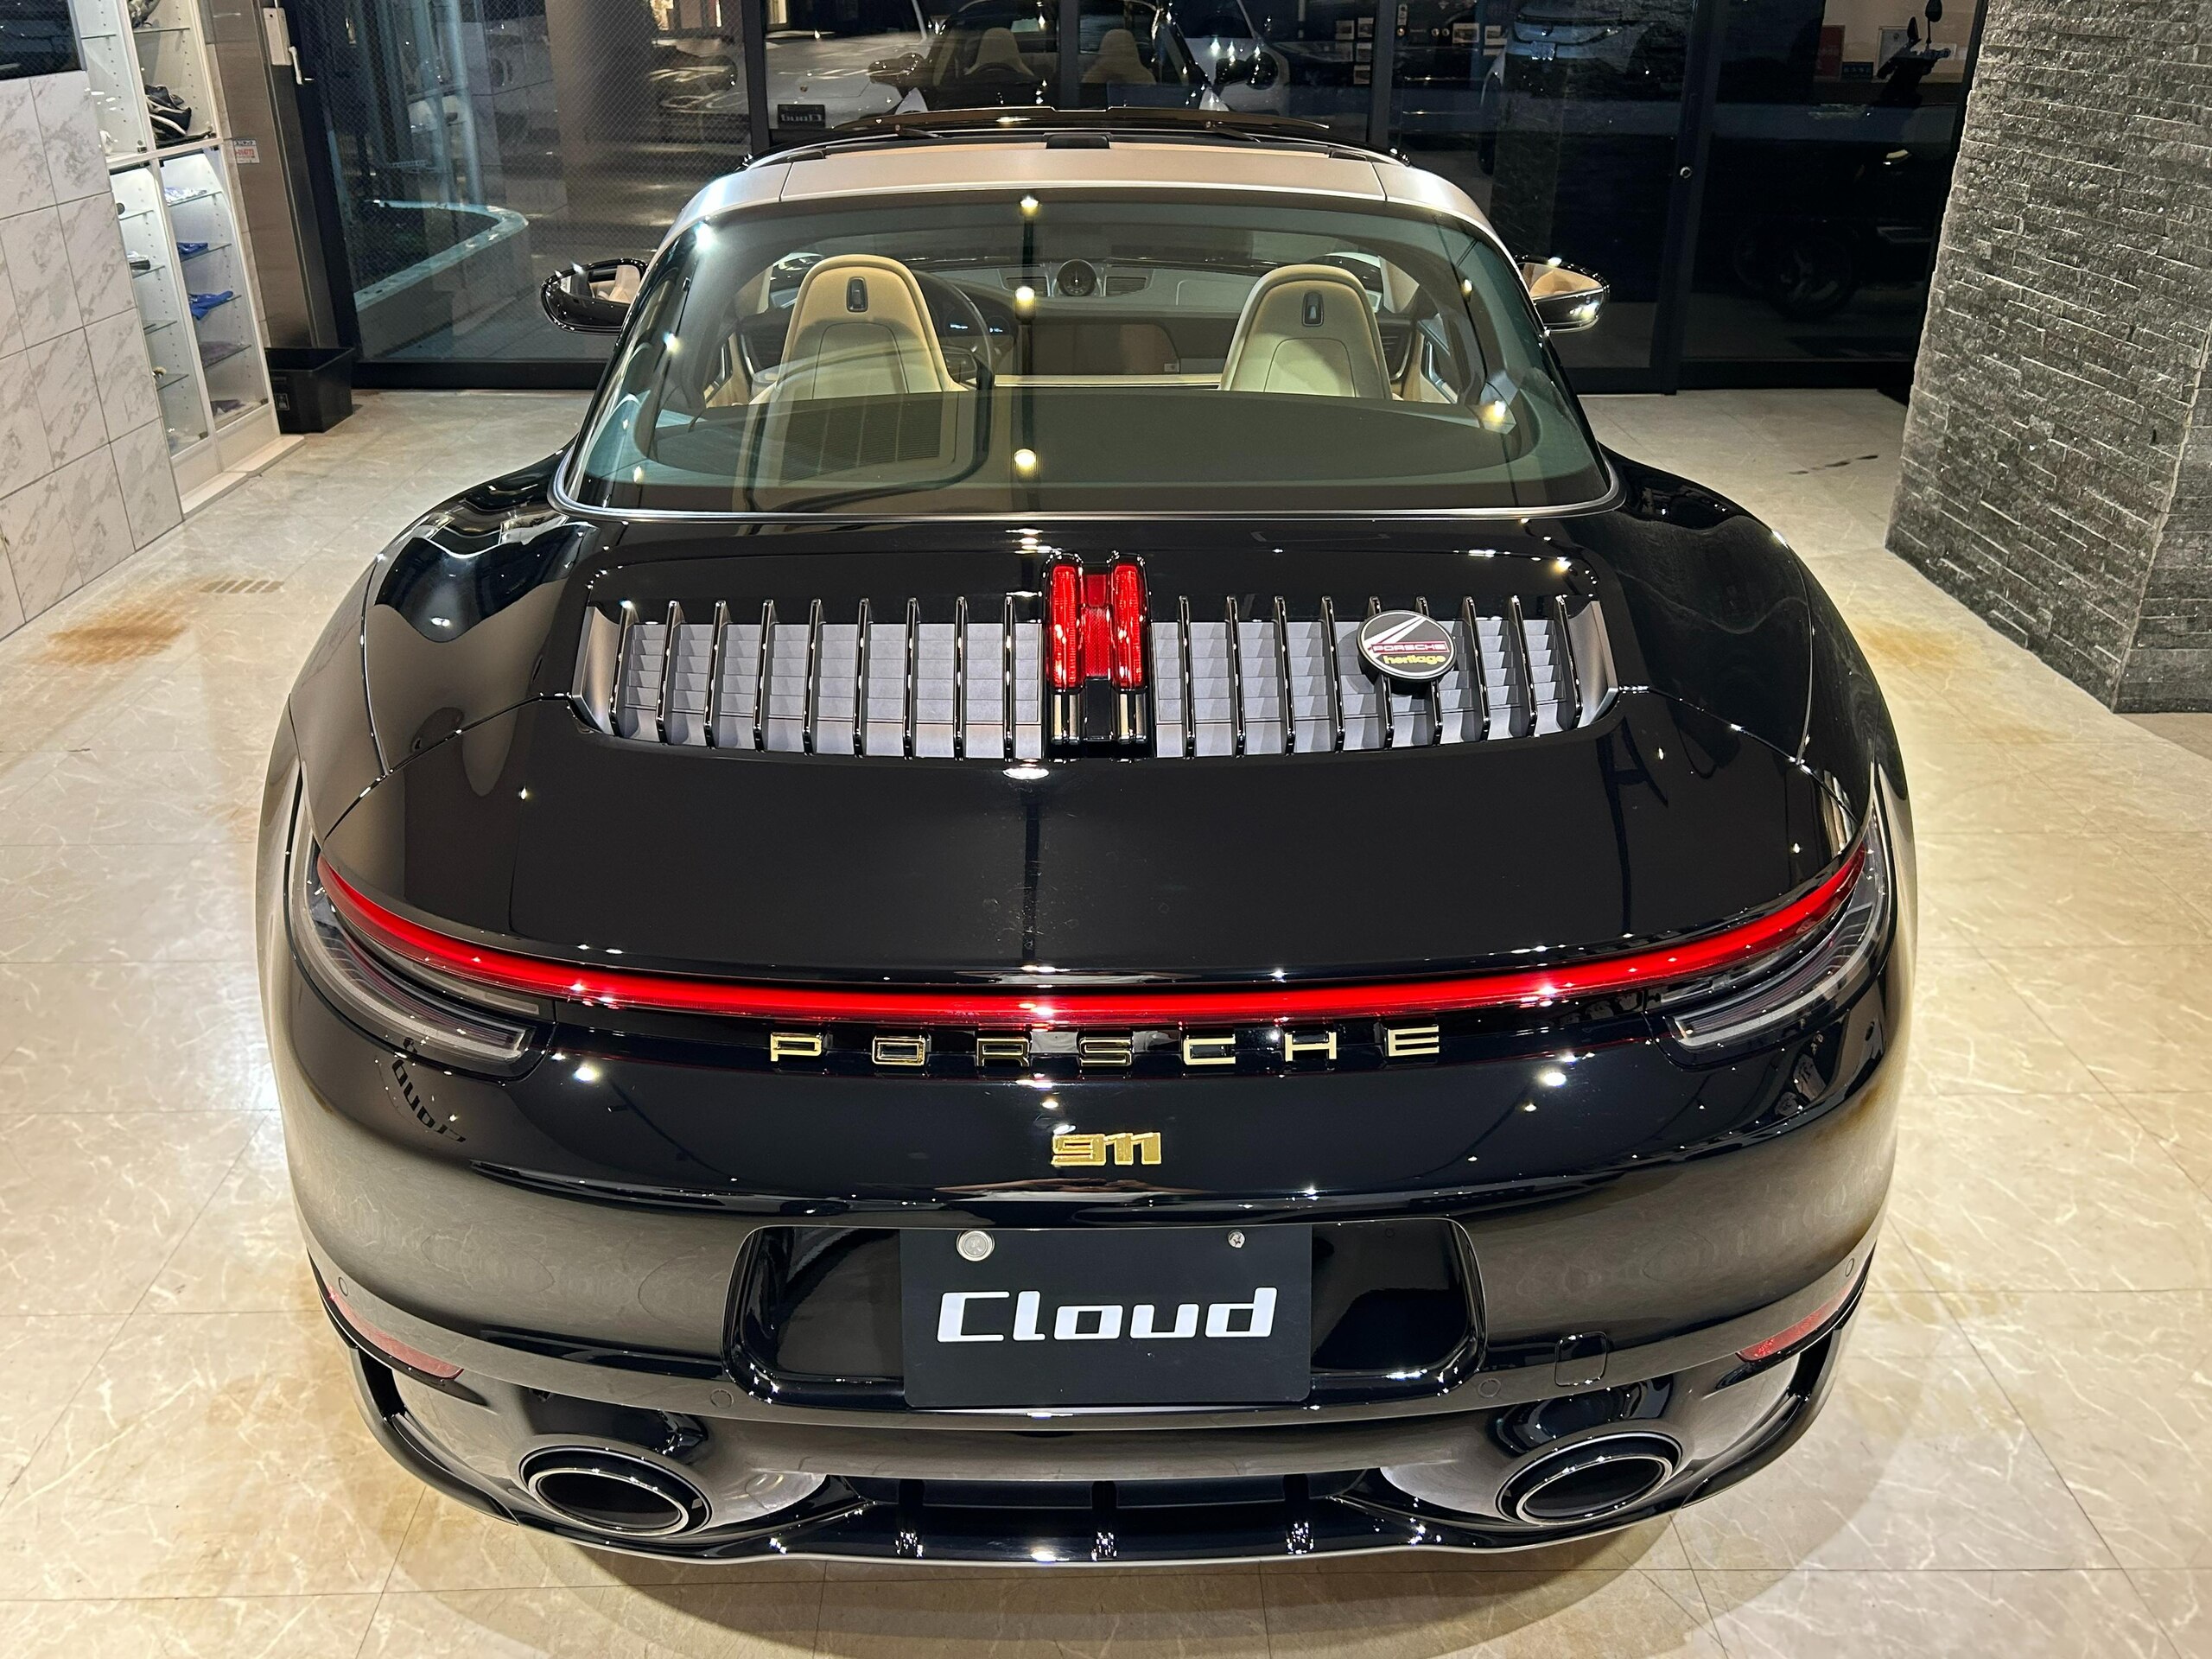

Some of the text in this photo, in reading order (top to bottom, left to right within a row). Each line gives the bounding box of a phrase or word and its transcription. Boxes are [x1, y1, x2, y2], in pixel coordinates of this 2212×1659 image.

[1372, 644, 1446, 652] PORSCHE
[1382, 655, 1446, 665] heritage
[770, 1024, 1440, 1067] PORSCHE
[1051, 1132, 1161, 1166] 911
[937, 1287, 1278, 1343] Cloud
